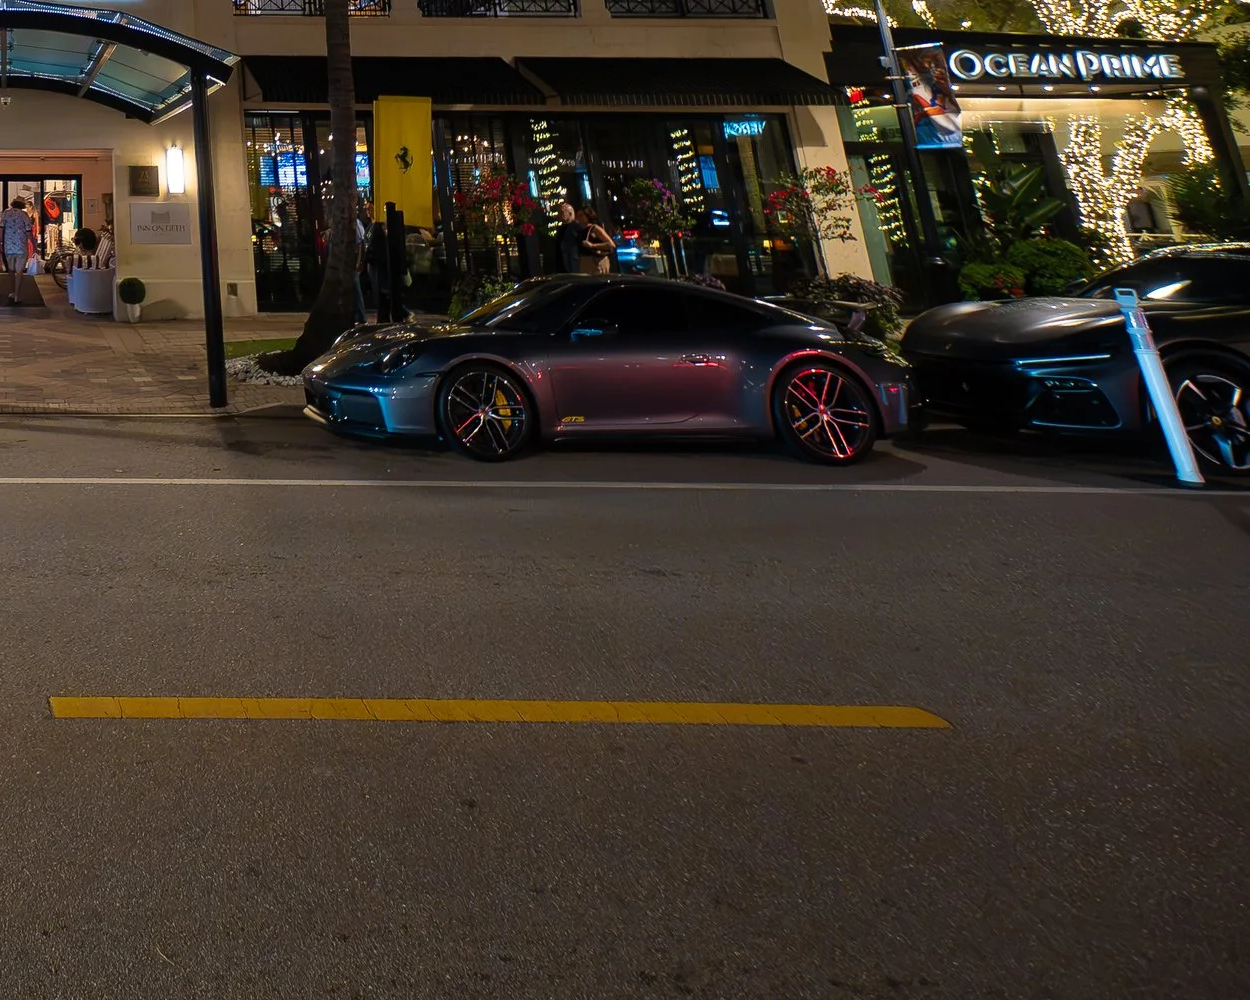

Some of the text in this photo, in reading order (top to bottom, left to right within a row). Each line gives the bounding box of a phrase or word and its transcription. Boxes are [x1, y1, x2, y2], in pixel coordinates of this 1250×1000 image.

[950, 50, 1186, 81] OCEAN PRIME
[151, 224, 164, 232] ON
